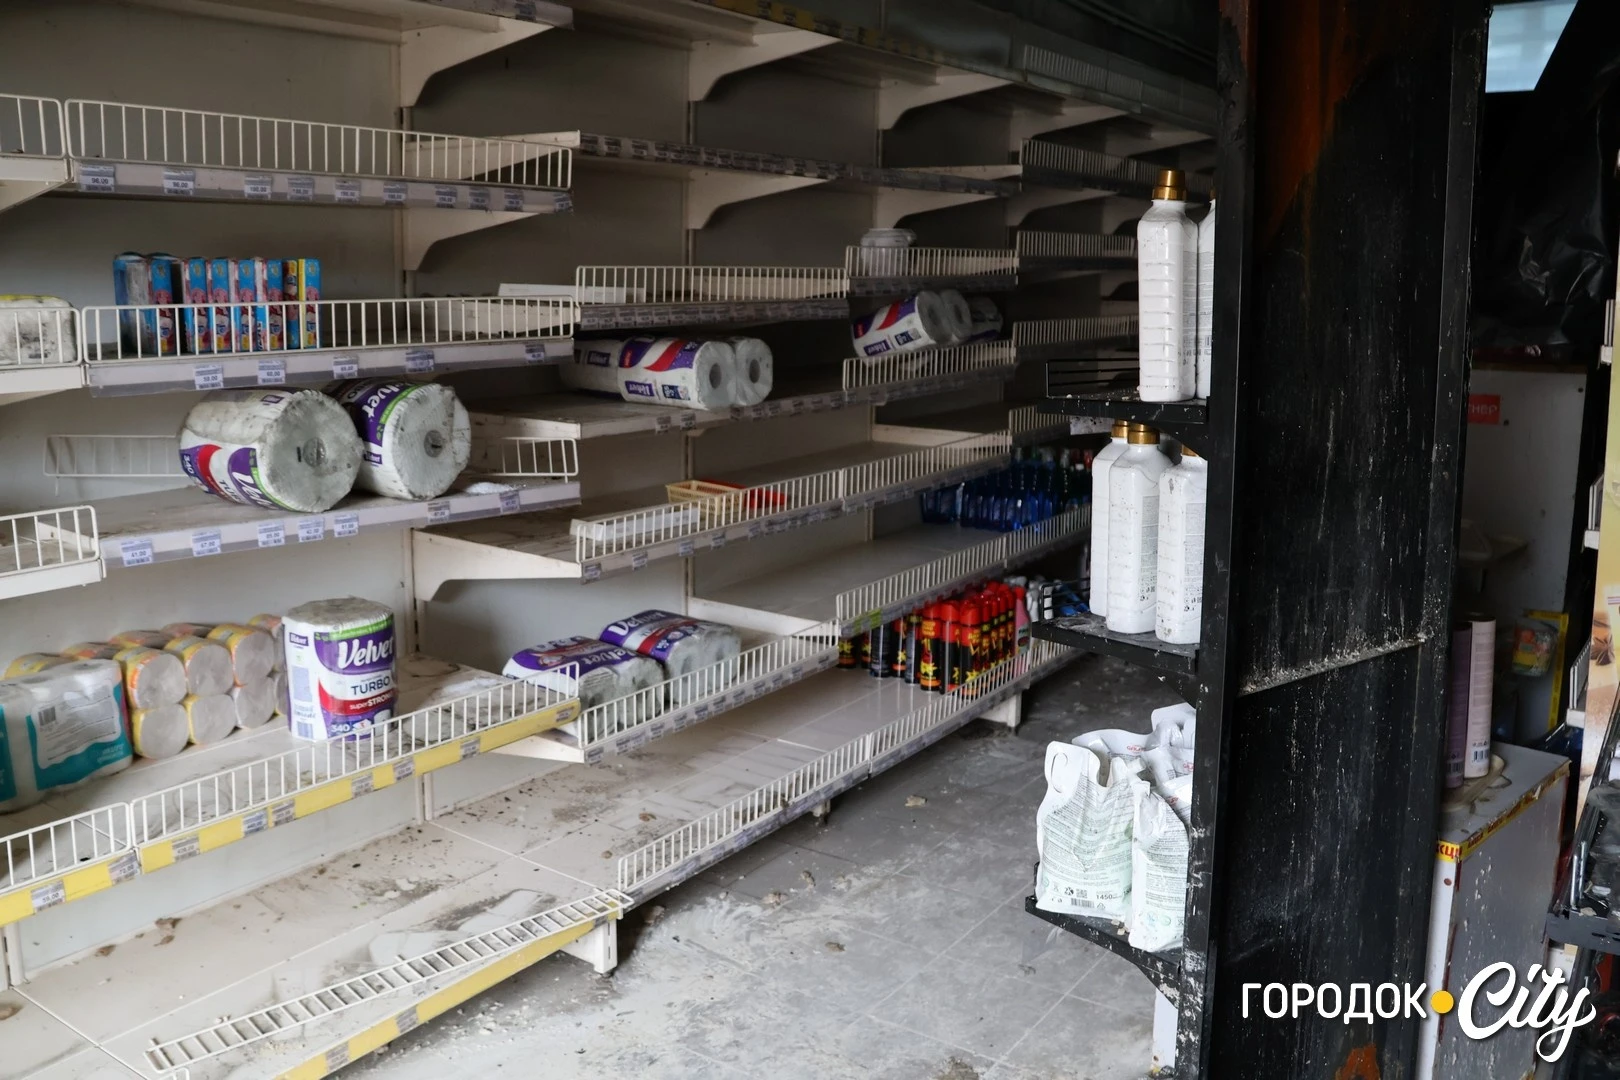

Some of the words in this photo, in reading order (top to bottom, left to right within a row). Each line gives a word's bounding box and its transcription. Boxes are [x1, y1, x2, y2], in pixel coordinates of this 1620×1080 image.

[338, 637, 394, 669] Velvet
[351, 676, 391, 696] TURBO
[331, 722, 351, 733] 340
